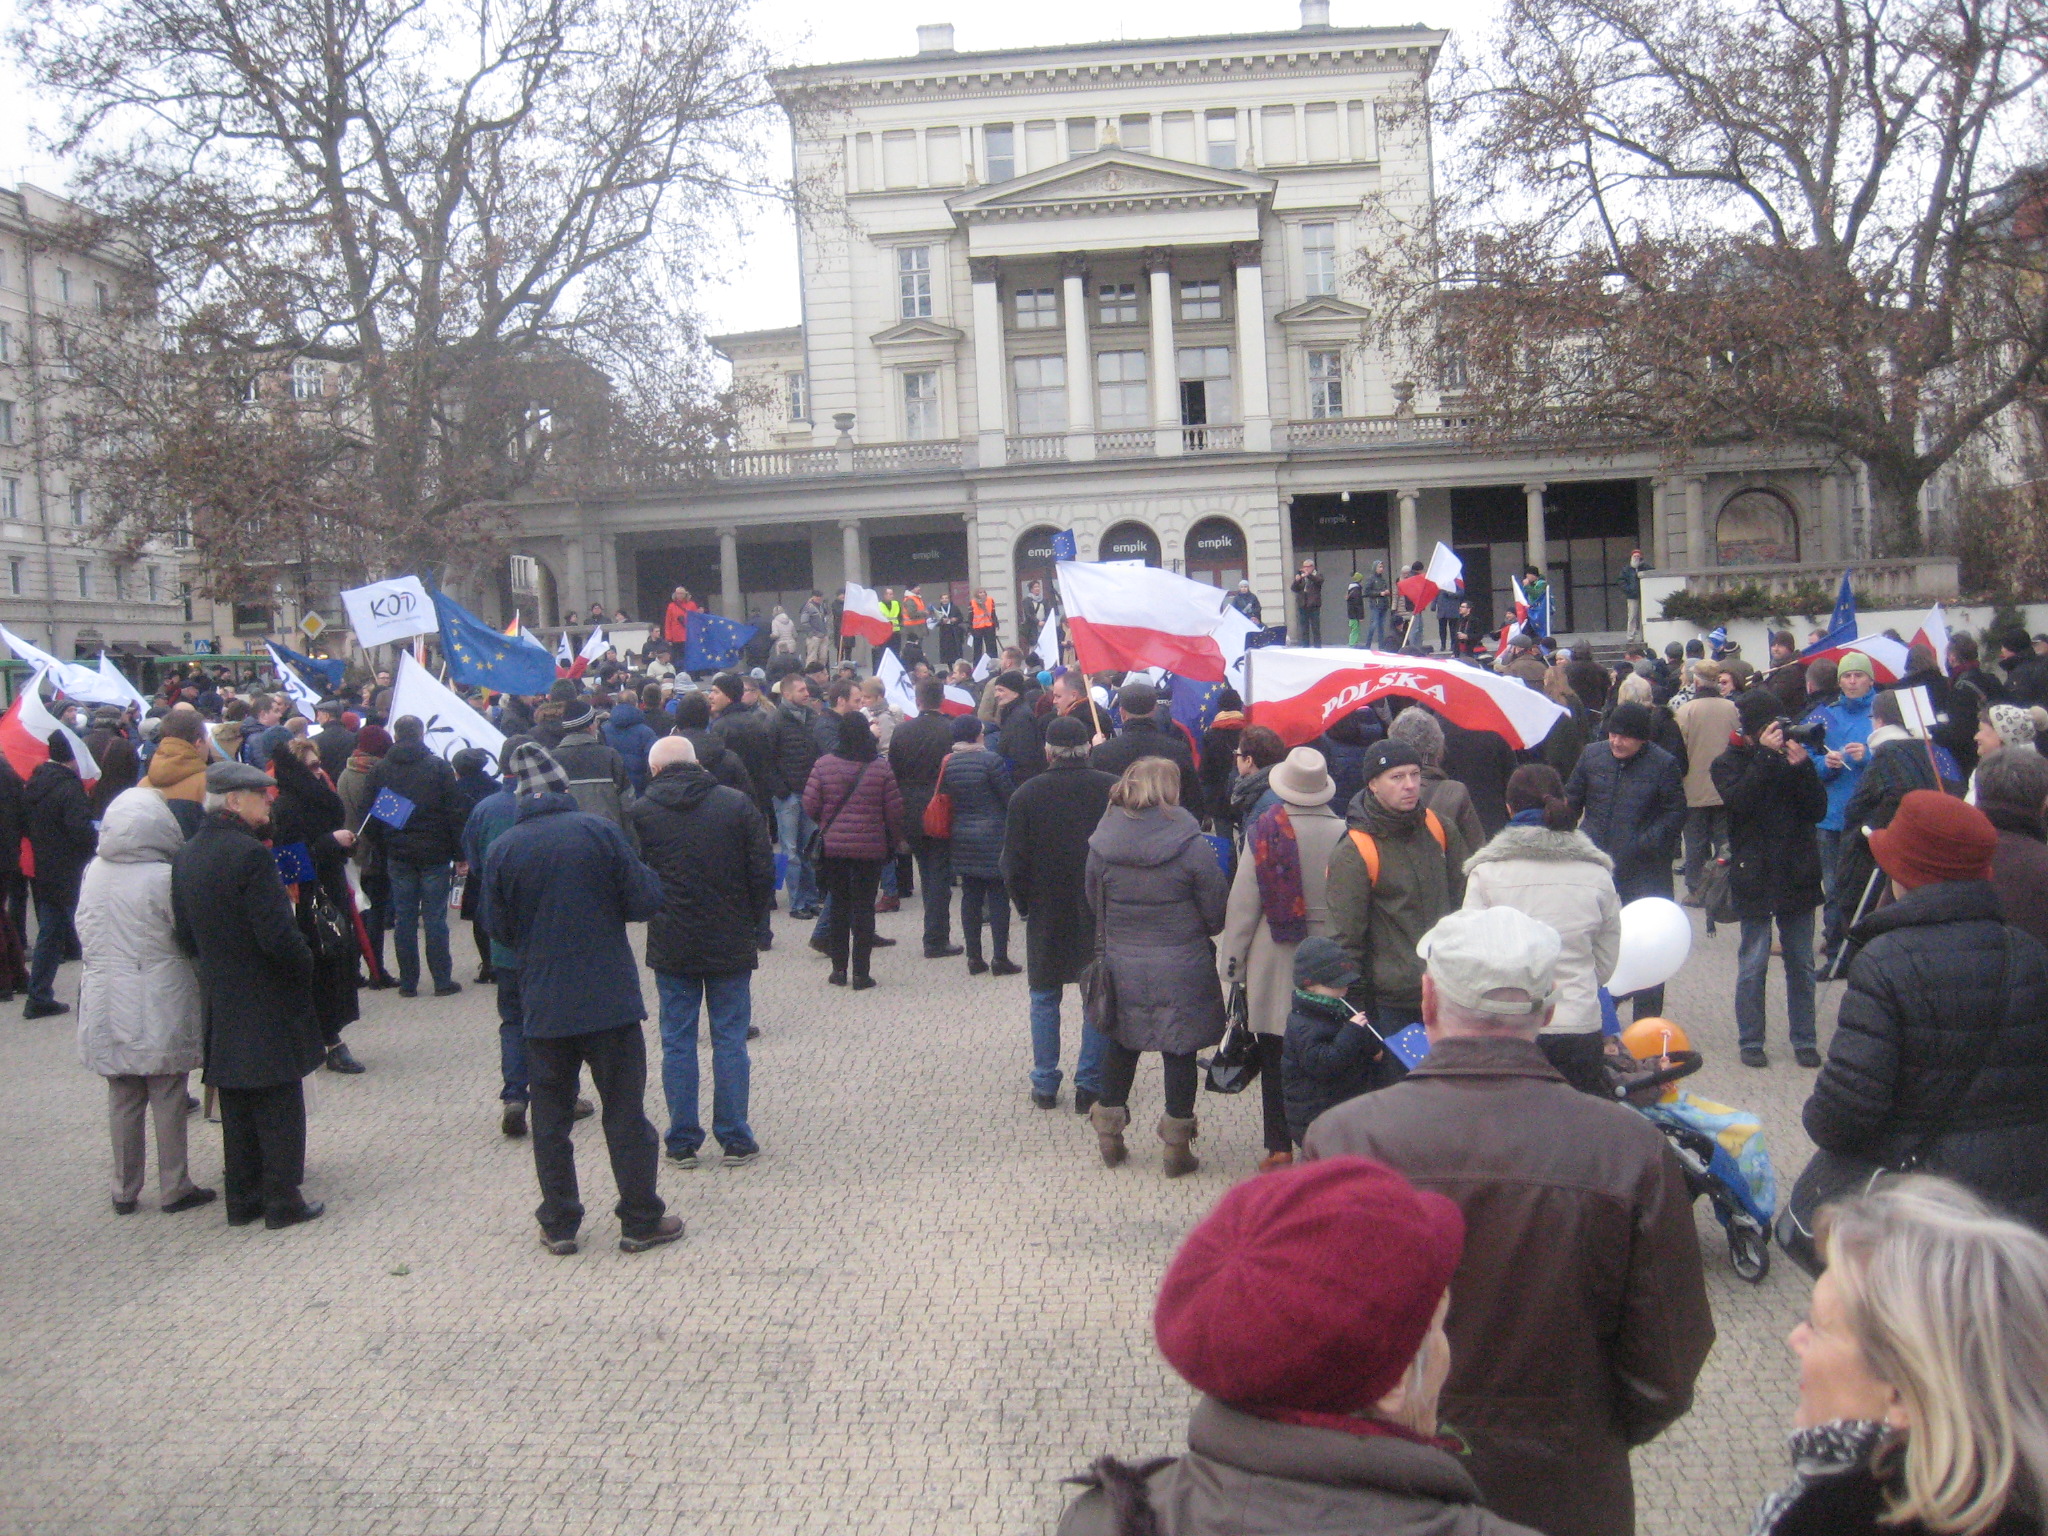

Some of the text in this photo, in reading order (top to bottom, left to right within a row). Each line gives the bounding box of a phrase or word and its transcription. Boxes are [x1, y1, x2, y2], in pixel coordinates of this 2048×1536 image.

[1113, 540, 1148, 555] empik
[1198, 535, 1233, 549] empik
[912, 550, 940, 560] empik
[1028, 548, 1054, 558] emp
[370, 591, 417, 620] KOD
[1321, 671, 1447, 725] POLSKA
